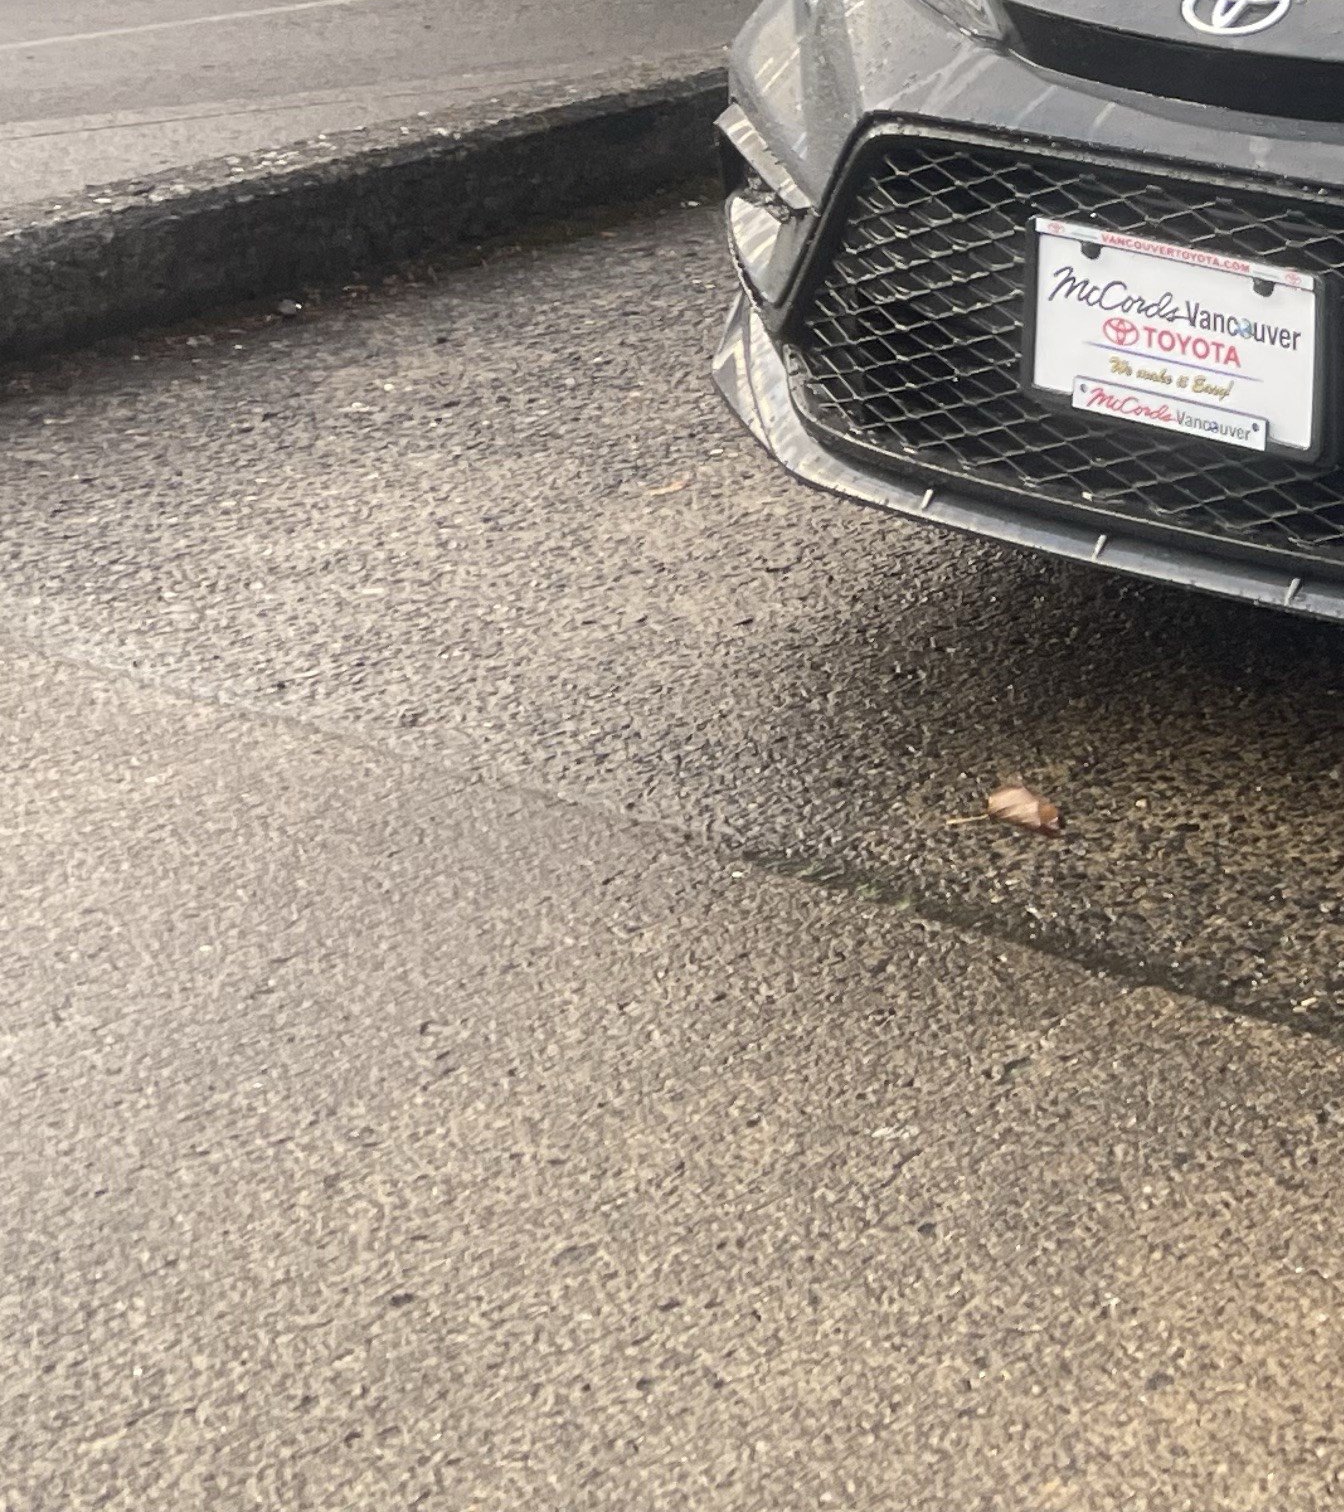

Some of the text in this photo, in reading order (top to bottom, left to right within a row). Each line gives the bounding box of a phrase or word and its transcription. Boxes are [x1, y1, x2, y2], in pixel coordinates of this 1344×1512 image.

[1101, 232, 1250, 273] VANCOUVERTOYOTA.COM
[1048, 265, 1302, 351] McCords Vancouver
[1143, 325, 1242, 368] TOYOTA
[1085, 387, 1252, 441] McCords Vancouver
